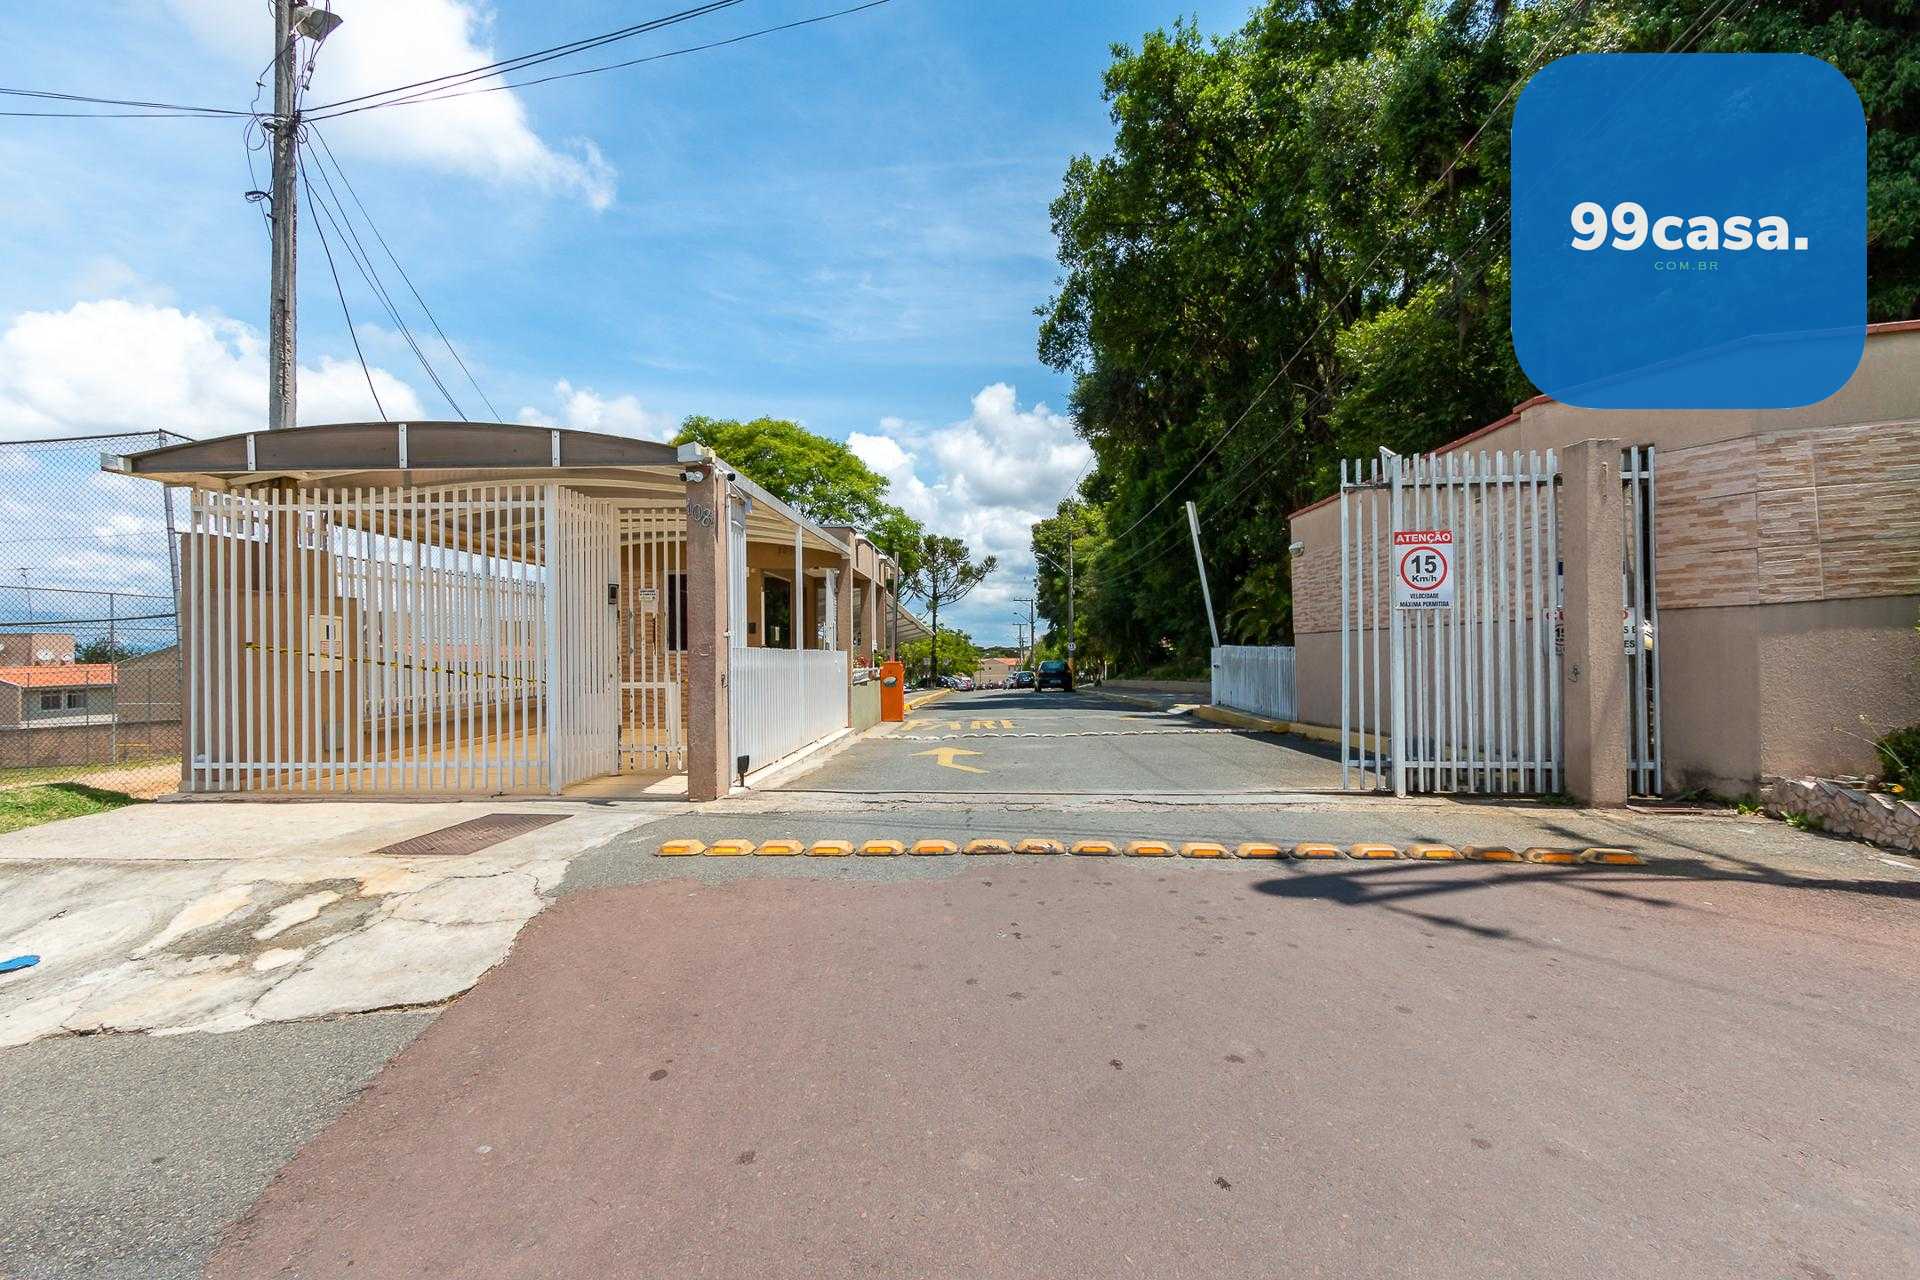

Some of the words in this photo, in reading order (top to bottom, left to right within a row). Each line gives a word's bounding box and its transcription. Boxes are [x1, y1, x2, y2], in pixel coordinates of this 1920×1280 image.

[1397, 531, 1450, 543] ATENÇÃO
[1411, 555, 1437, 574] 15
[1412, 574, 1437, 582] Km/h
